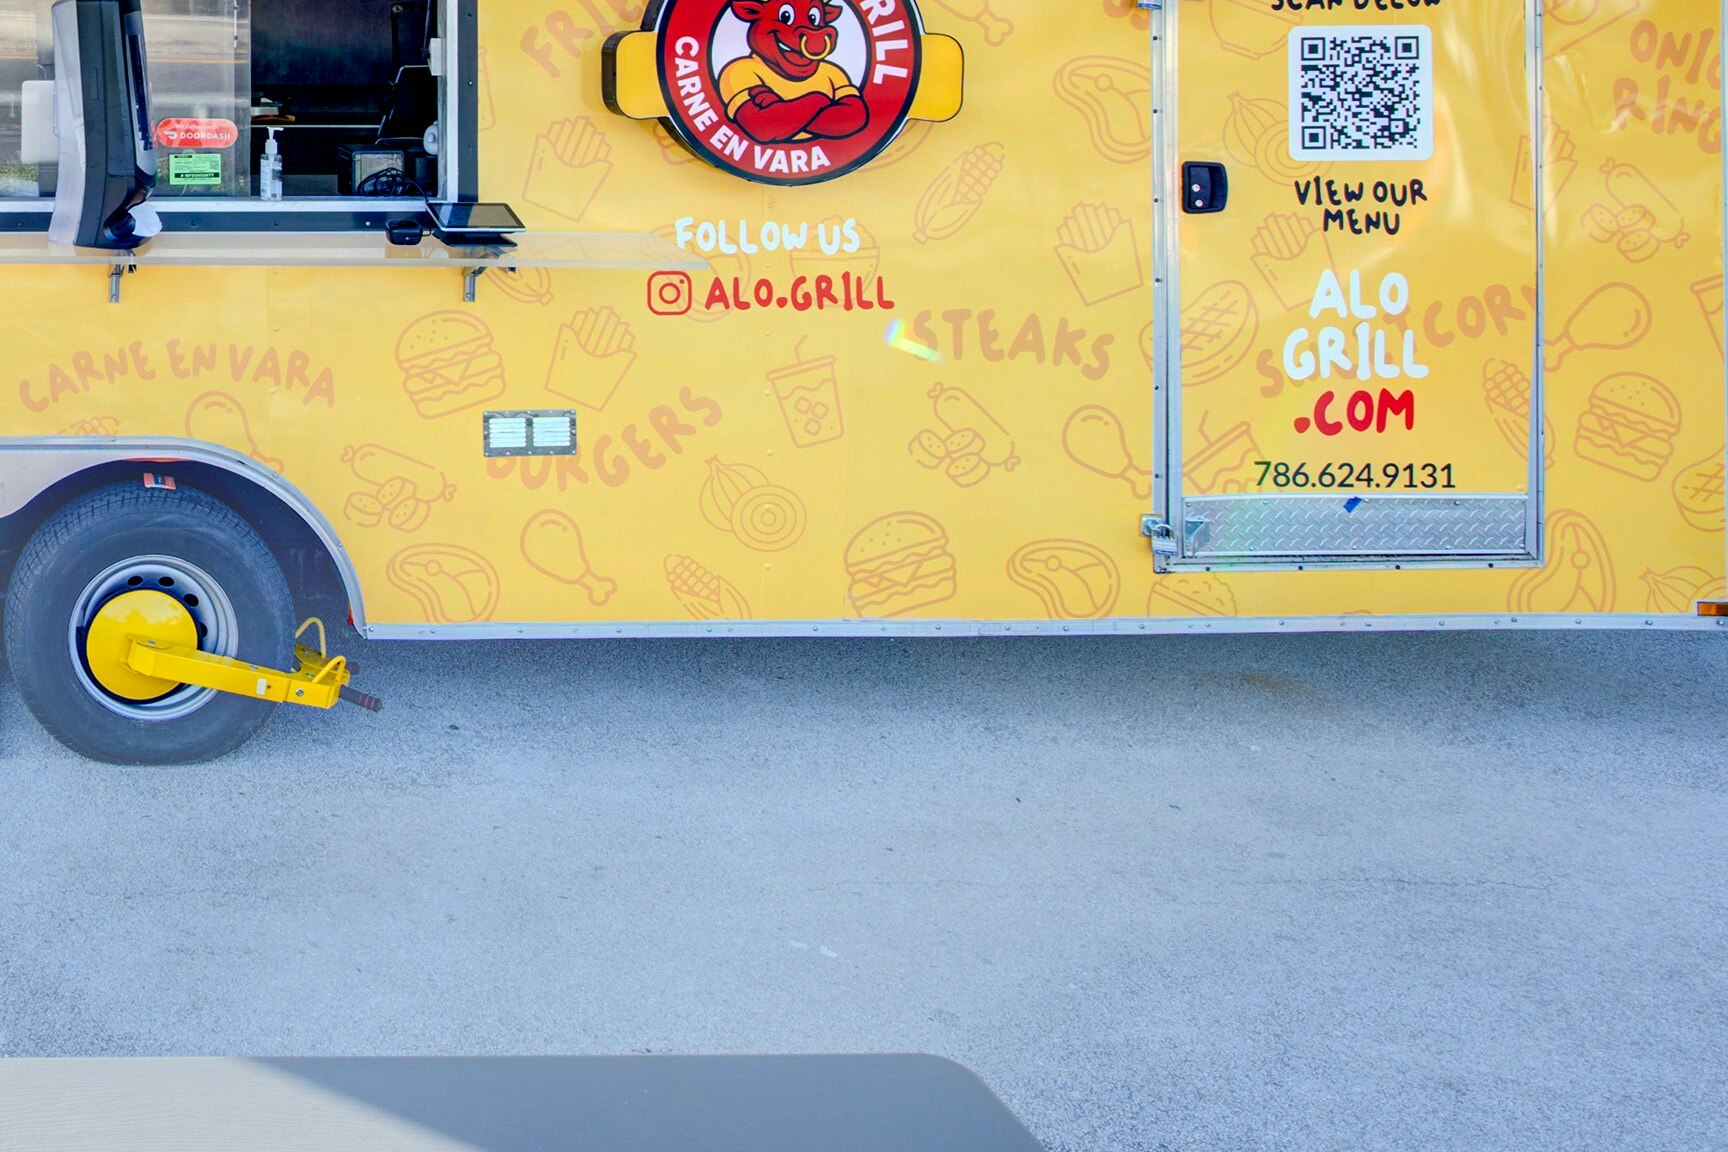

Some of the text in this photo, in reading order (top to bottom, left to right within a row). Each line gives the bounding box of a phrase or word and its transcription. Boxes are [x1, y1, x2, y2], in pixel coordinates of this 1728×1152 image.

[673, 35, 830, 174] CARNE EN VARA
[1294, 175, 1428, 208] VIEW OUR
[674, 215, 860, 255] FOLLOW US
[1323, 210, 1400, 236] MENU
[704, 271, 895, 312] ALO.GRILL
[1309, 269, 1409, 319] ALO
[913, 308, 1115, 381] STEAKS
[1282, 322, 1430, 380] GRILL
[19, 338, 335, 412] CARNE EN VARA
[1292, 388, 1414, 436] .COM
[1254, 460, 1456, 489] 786.624.9131
